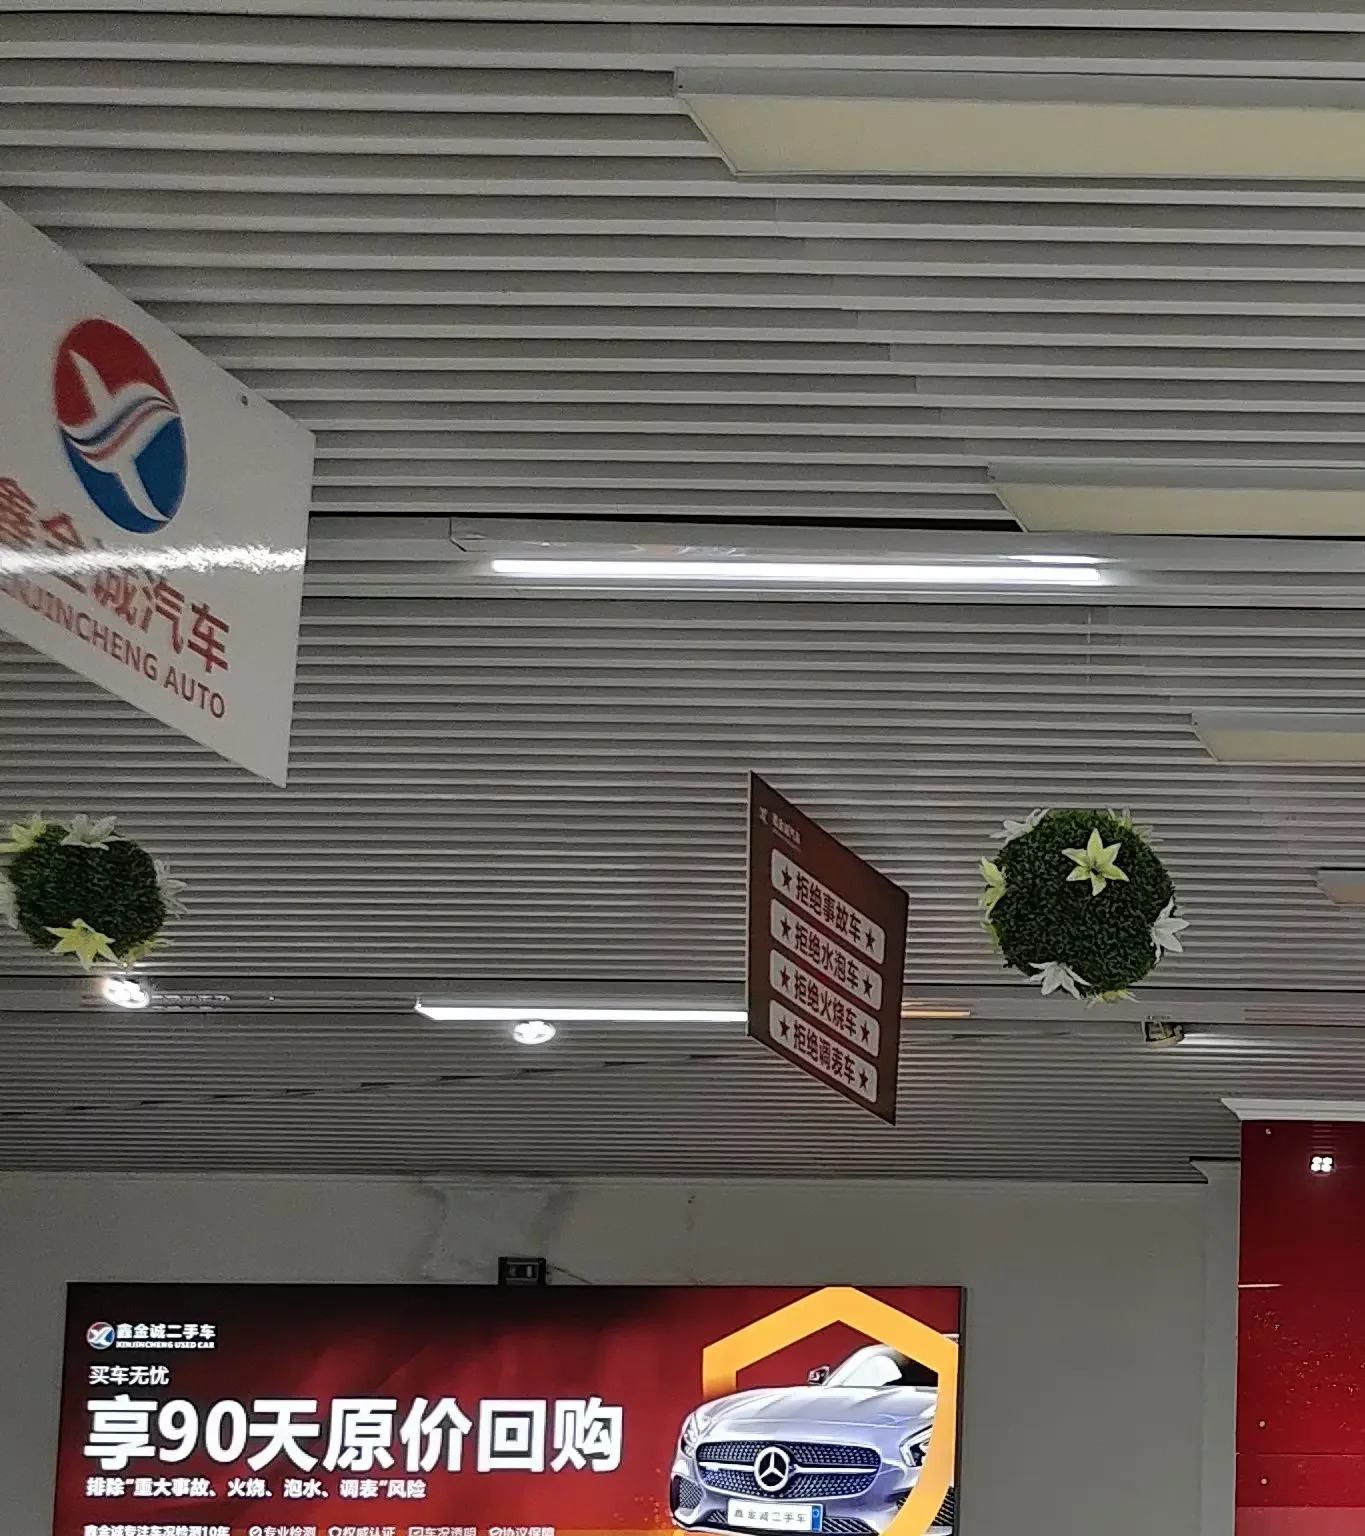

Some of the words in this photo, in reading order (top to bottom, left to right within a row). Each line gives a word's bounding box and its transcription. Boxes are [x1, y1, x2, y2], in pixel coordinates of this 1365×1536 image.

[163, 665, 226, 719] AUTO
[795, 871, 862, 944] 拒绝事故车
[794, 922, 860, 990] 拒绝水泡车
[794, 973, 858, 1039] 拒绝火烧车
[793, 1021, 857, 1087] 拒绝调表车
[116, 1323, 217, 1341] 鑫金诚二手车
[88, 1364, 170, 1387] 买车无忧
[83, 1393, 624, 1474] 享90天原价回购
